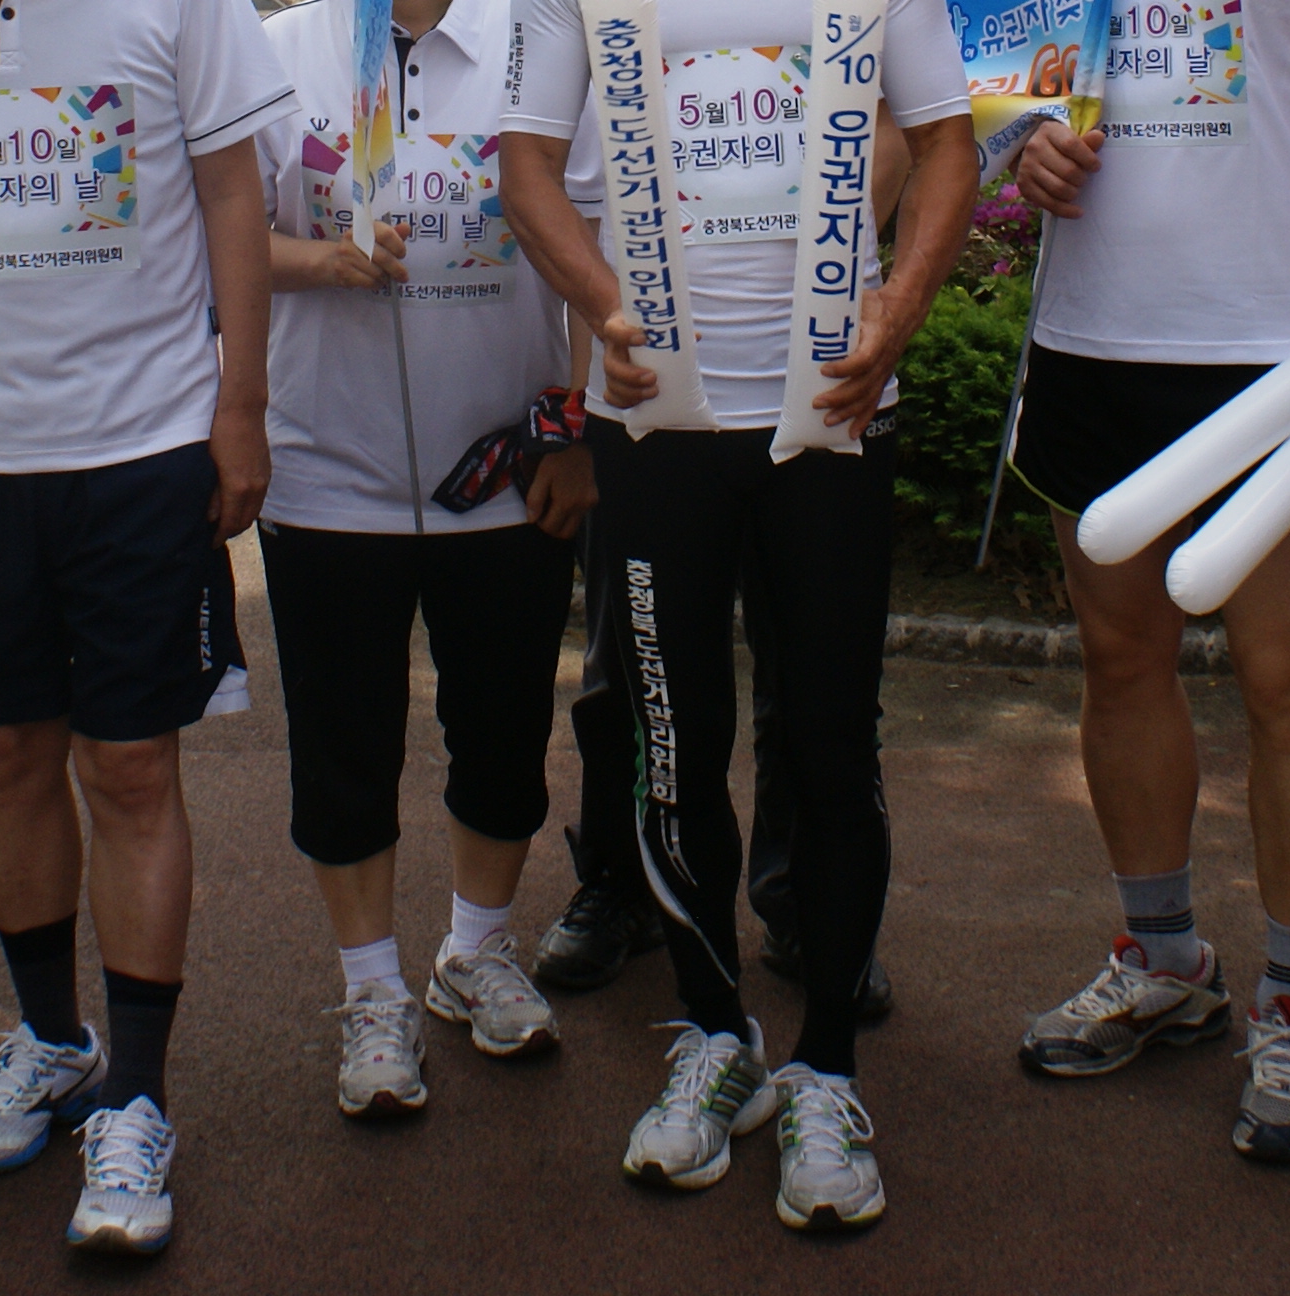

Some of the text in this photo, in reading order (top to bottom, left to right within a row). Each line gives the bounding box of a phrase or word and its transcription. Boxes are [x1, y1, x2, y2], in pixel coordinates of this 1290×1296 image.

[1185, 45, 1213, 74] 날
[73, 170, 104, 201] 날
[594, 17, 681, 354] 충청북도선거관리위원회
[461, 211, 488, 242] 날
